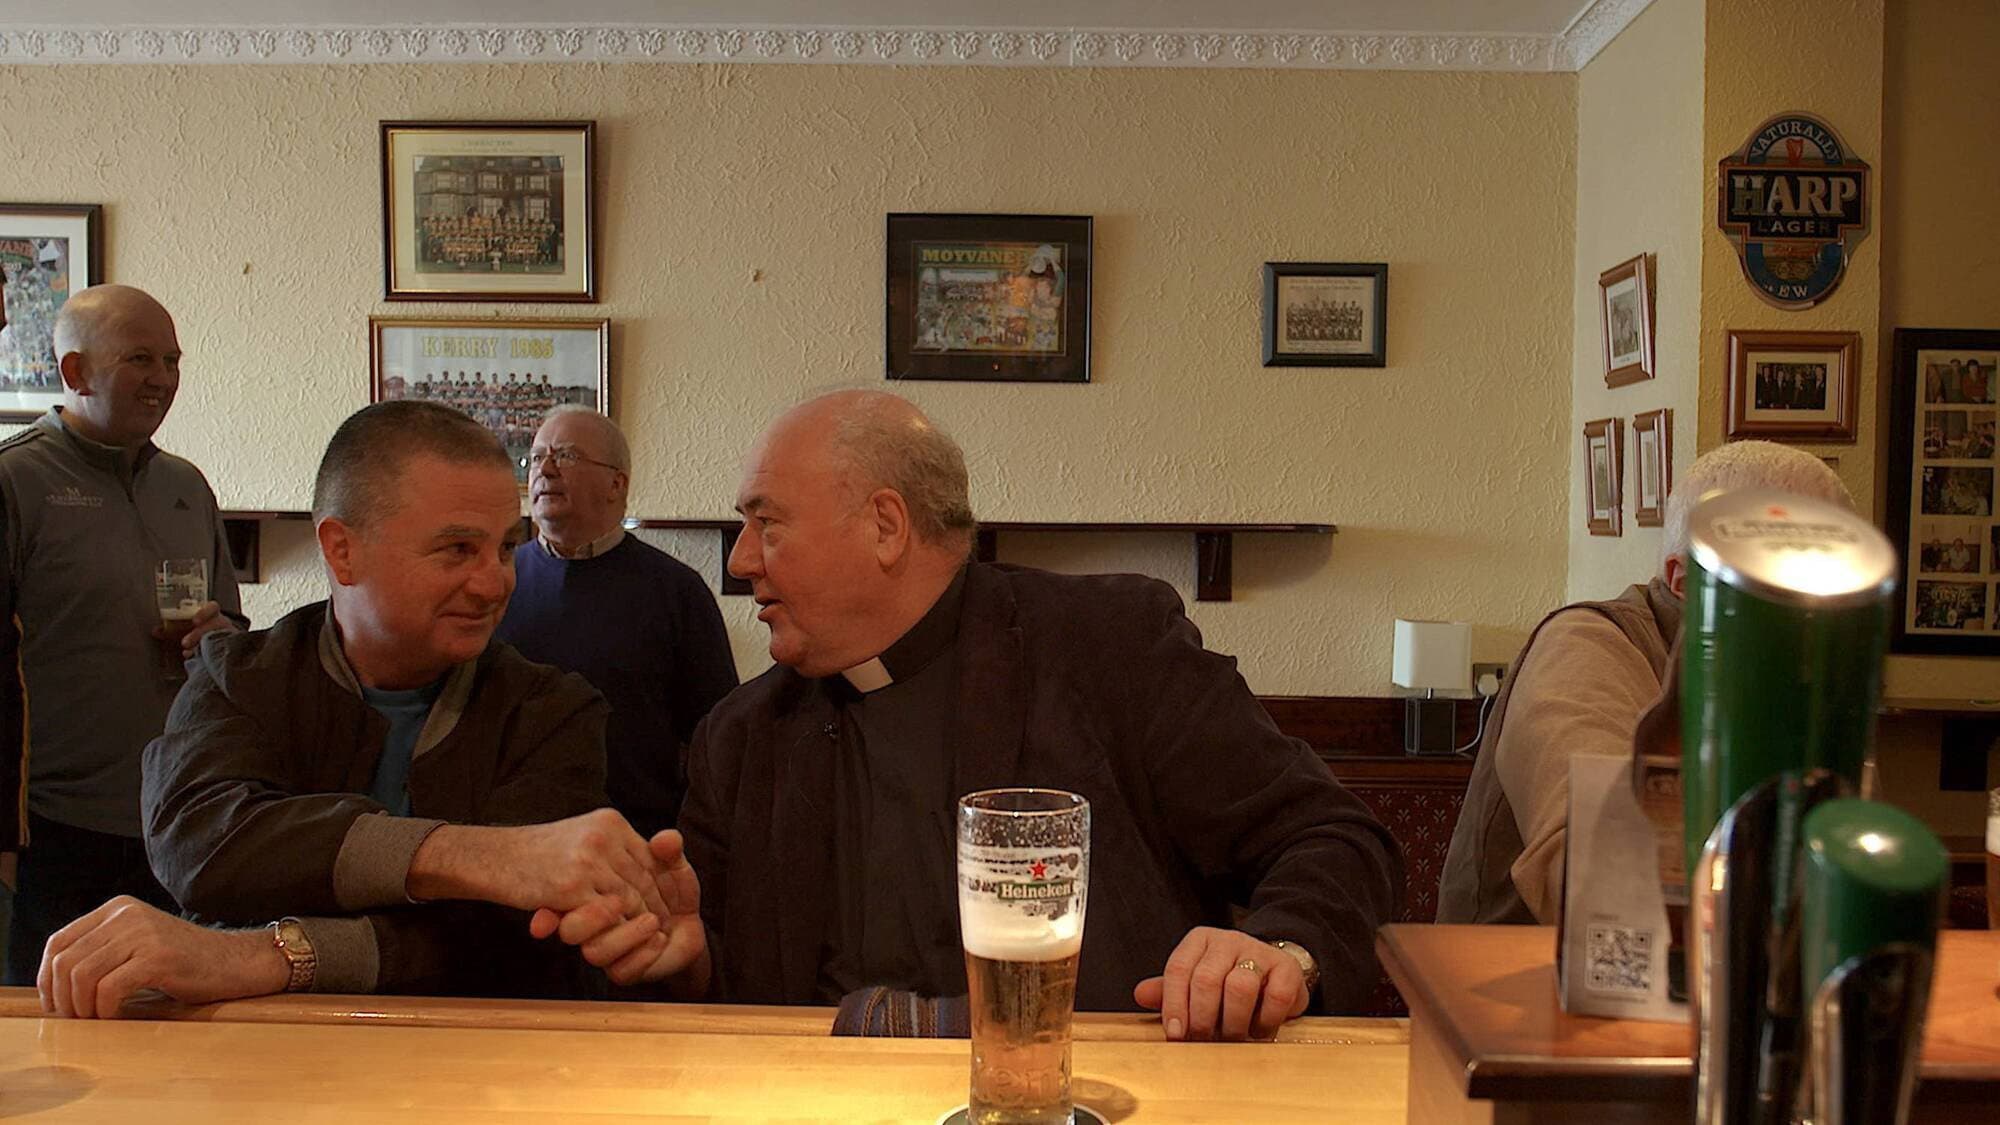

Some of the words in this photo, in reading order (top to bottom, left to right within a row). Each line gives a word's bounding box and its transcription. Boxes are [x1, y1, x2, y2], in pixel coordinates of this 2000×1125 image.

[1751, 121, 1840, 160] NATURALLY
[1731, 175, 1857, 216] HARP
[1758, 219, 1832, 233] LAGER
[423, 336, 499, 358] KERRY
[511, 337, 554, 359] 1985
[1001, 882, 1072, 898] Heineken
